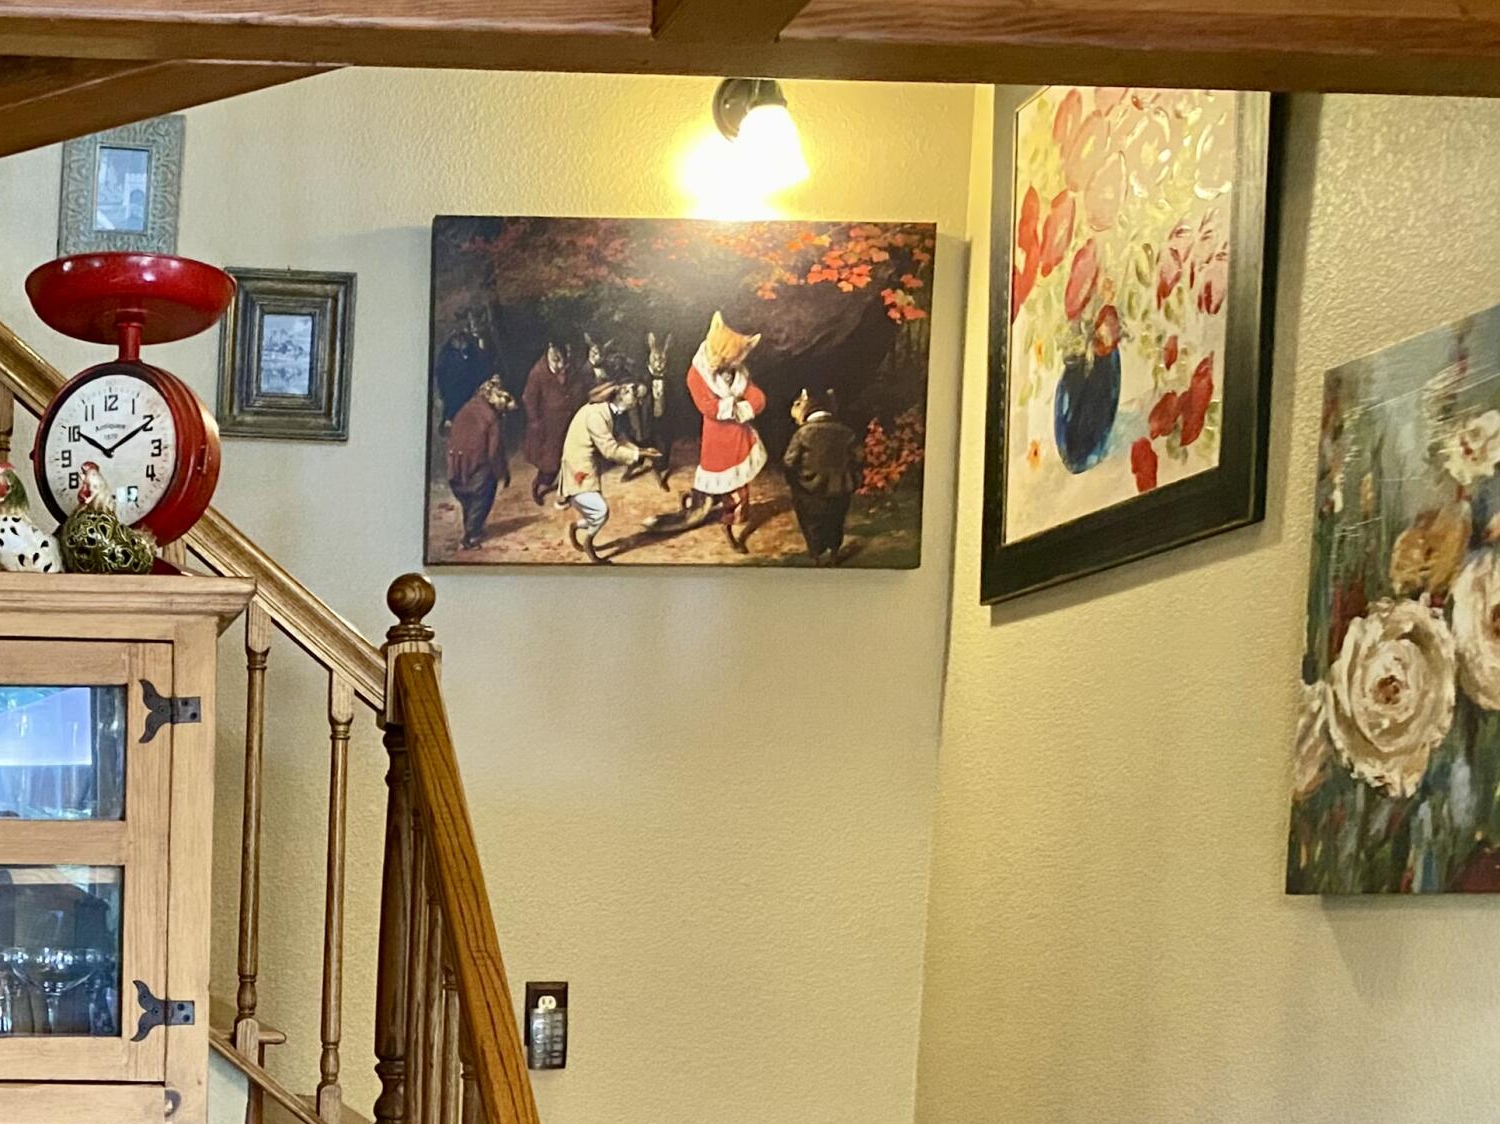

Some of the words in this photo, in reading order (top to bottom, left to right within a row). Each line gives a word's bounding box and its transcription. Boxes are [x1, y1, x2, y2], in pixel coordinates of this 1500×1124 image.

[104, 394, 119, 412] 12
[84, 404, 95, 422] 11
[142, 414, 155, 431] 2
[68, 425, 81, 443] 10
[151, 439, 162, 457] 3
[61, 450, 72, 468] 9
[68, 472, 79, 489] 8
[145, 464, 156, 481] 4
